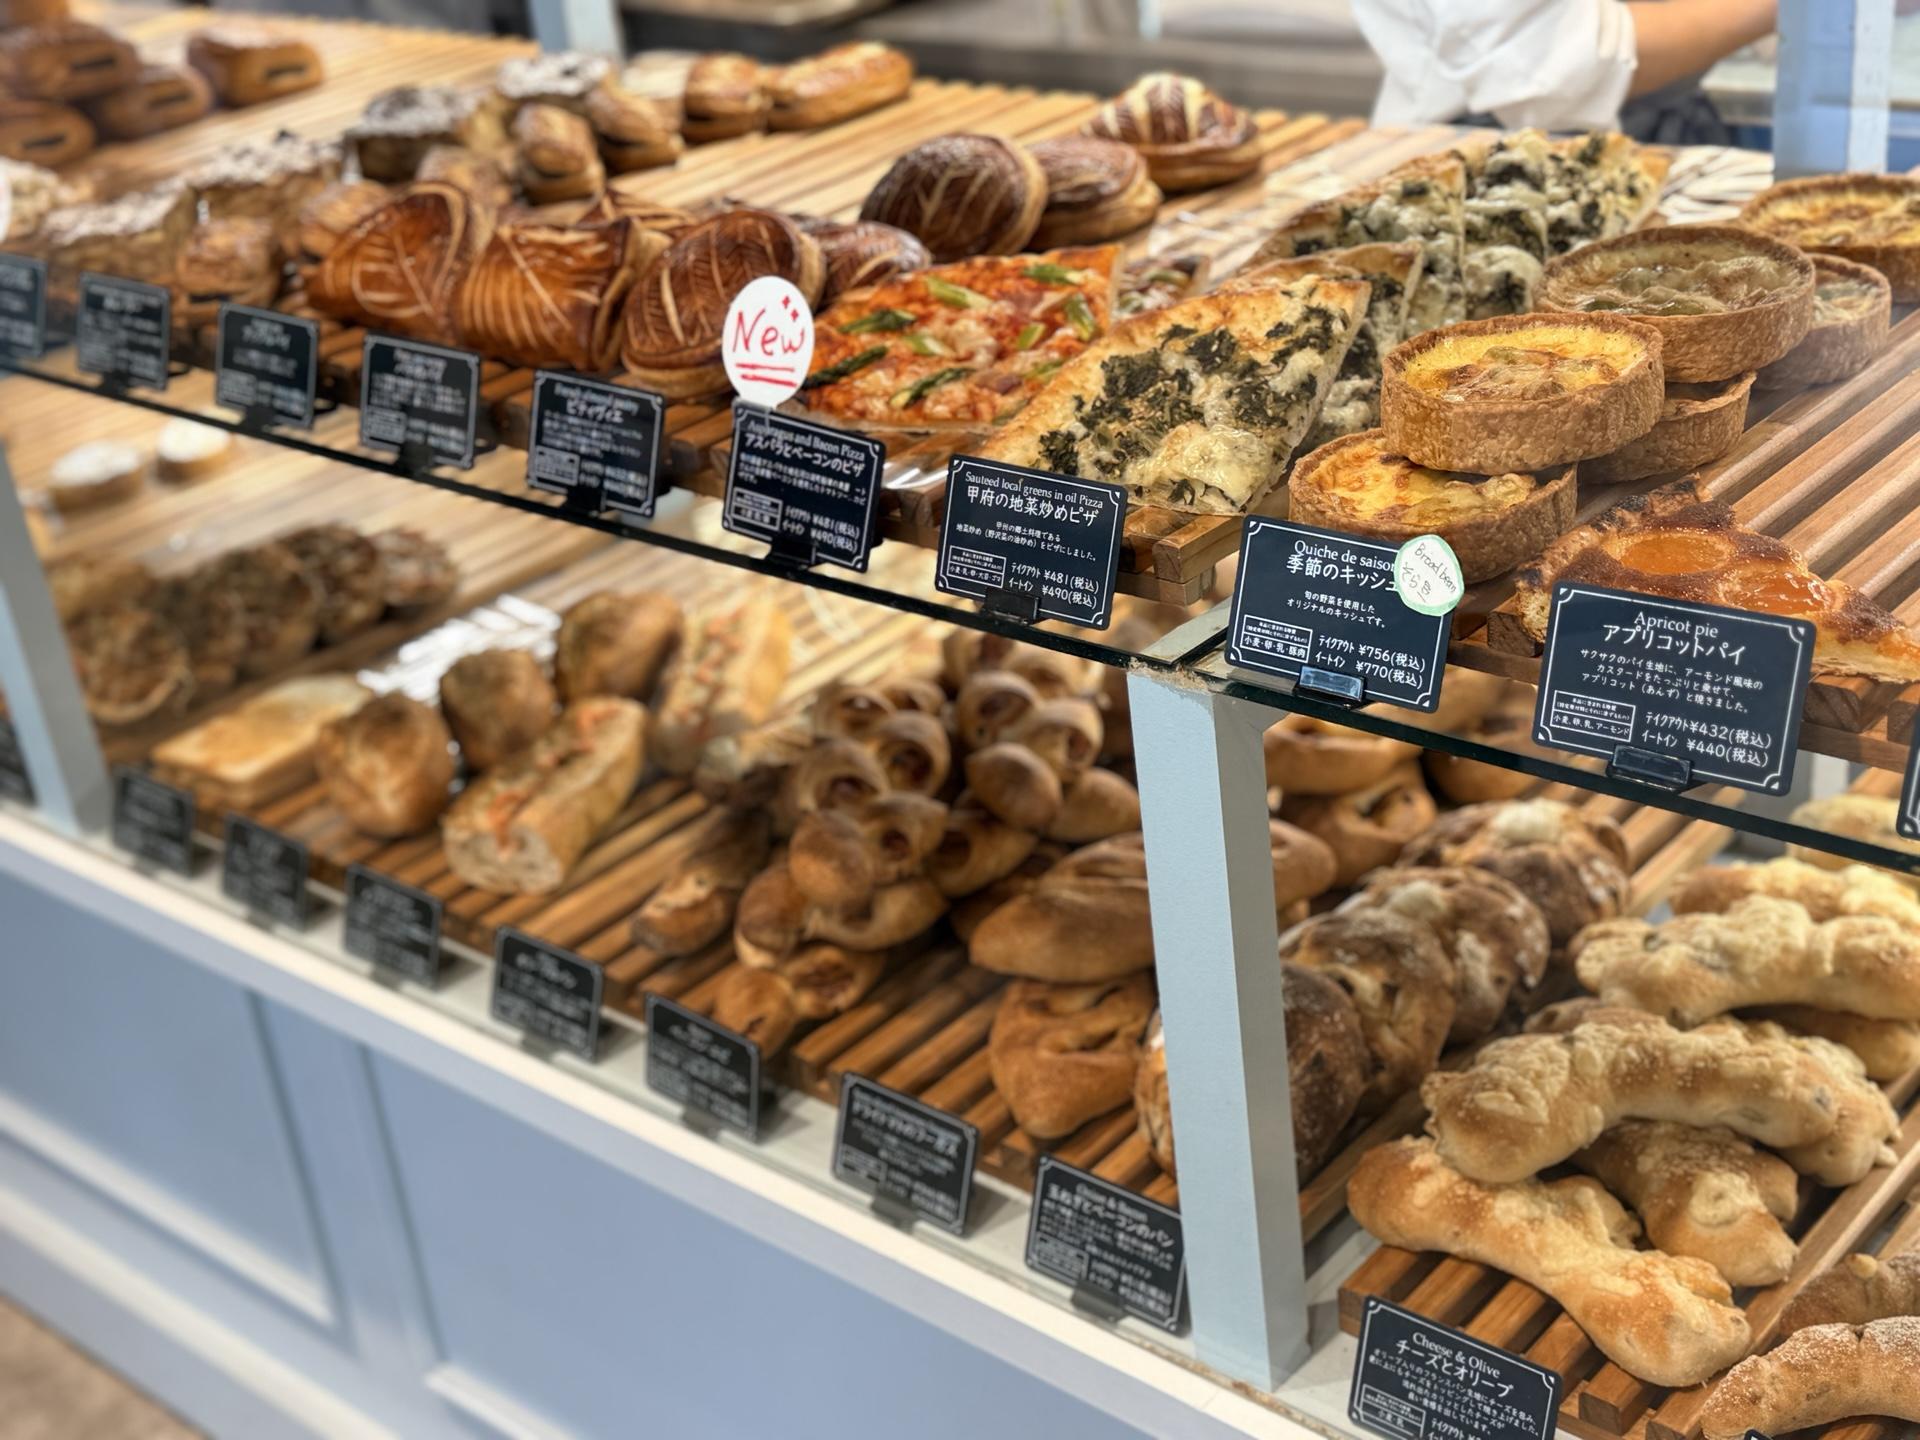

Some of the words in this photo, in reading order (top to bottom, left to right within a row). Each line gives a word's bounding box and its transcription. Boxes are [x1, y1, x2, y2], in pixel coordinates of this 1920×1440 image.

[733, 308, 805, 356] New
[794, 434, 812, 446] and
[813, 436, 839, 454] Bacon
[841, 444, 864, 461] Pizza
[966, 472, 999, 487] Sauteed
[1002, 478, 1022, 492] local
[1023, 486, 1052, 501] greens
[1054, 490, 1062, 500] in
[1065, 493, 1076, 503] oil
[1080, 494, 1103, 508] Pizza
[968, 486, 1099, 526] 甲府の地菜炒めピザ
[1295, 540, 1338, 560] Quiche
[1342, 550, 1356, 564] de
[1287, 554, 1397, 592] 季節のキッシュ
[1438, 567, 1457, 594] bean
[1288, 598, 1384, 628] オリジナルのキッシュです。
[1305, 591, 1374, 613] 旬の野菜を使用した
[1634, 612, 1690, 633] Apricot
[1694, 624, 1718, 638] pie
[1604, 625, 1745, 665] アプリコットパイ
[1581, 650, 1762, 690] サクサクのパイ生地に、アーモンド風味の
[1397, 1340, 1513, 1397] チーズとオリーブ
[1413, 1332, 1452, 1358] Cheese
[1455, 1351, 1465, 1364] &
[1469, 1356, 1500, 1378] Olive
